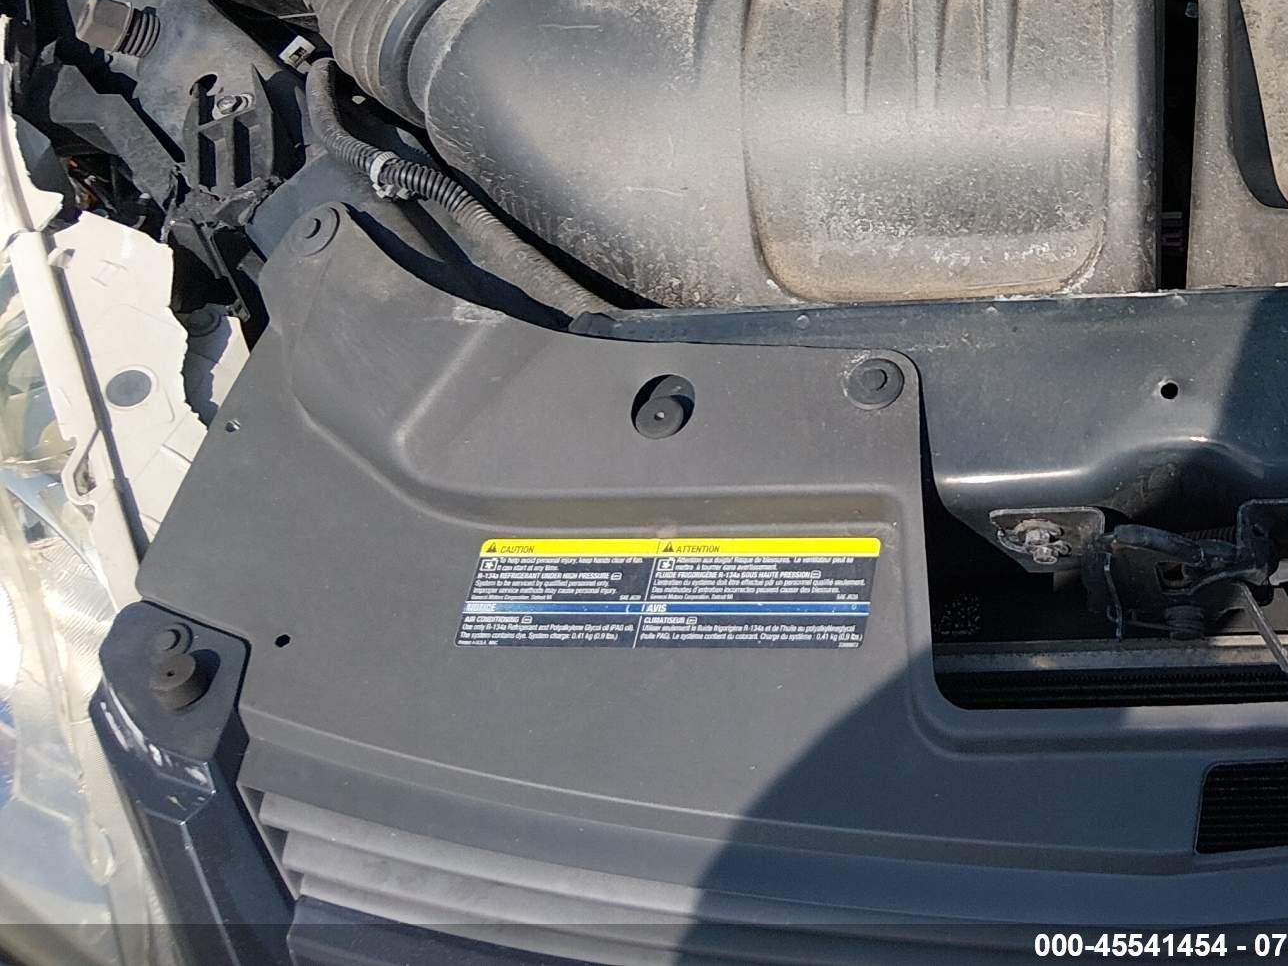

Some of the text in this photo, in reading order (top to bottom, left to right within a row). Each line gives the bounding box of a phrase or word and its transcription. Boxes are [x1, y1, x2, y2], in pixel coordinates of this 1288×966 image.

[500, 546, 535, 554] CAUTION
[676, 545, 720, 553] ATTENTION
[646, 604, 667, 612] AVIS
